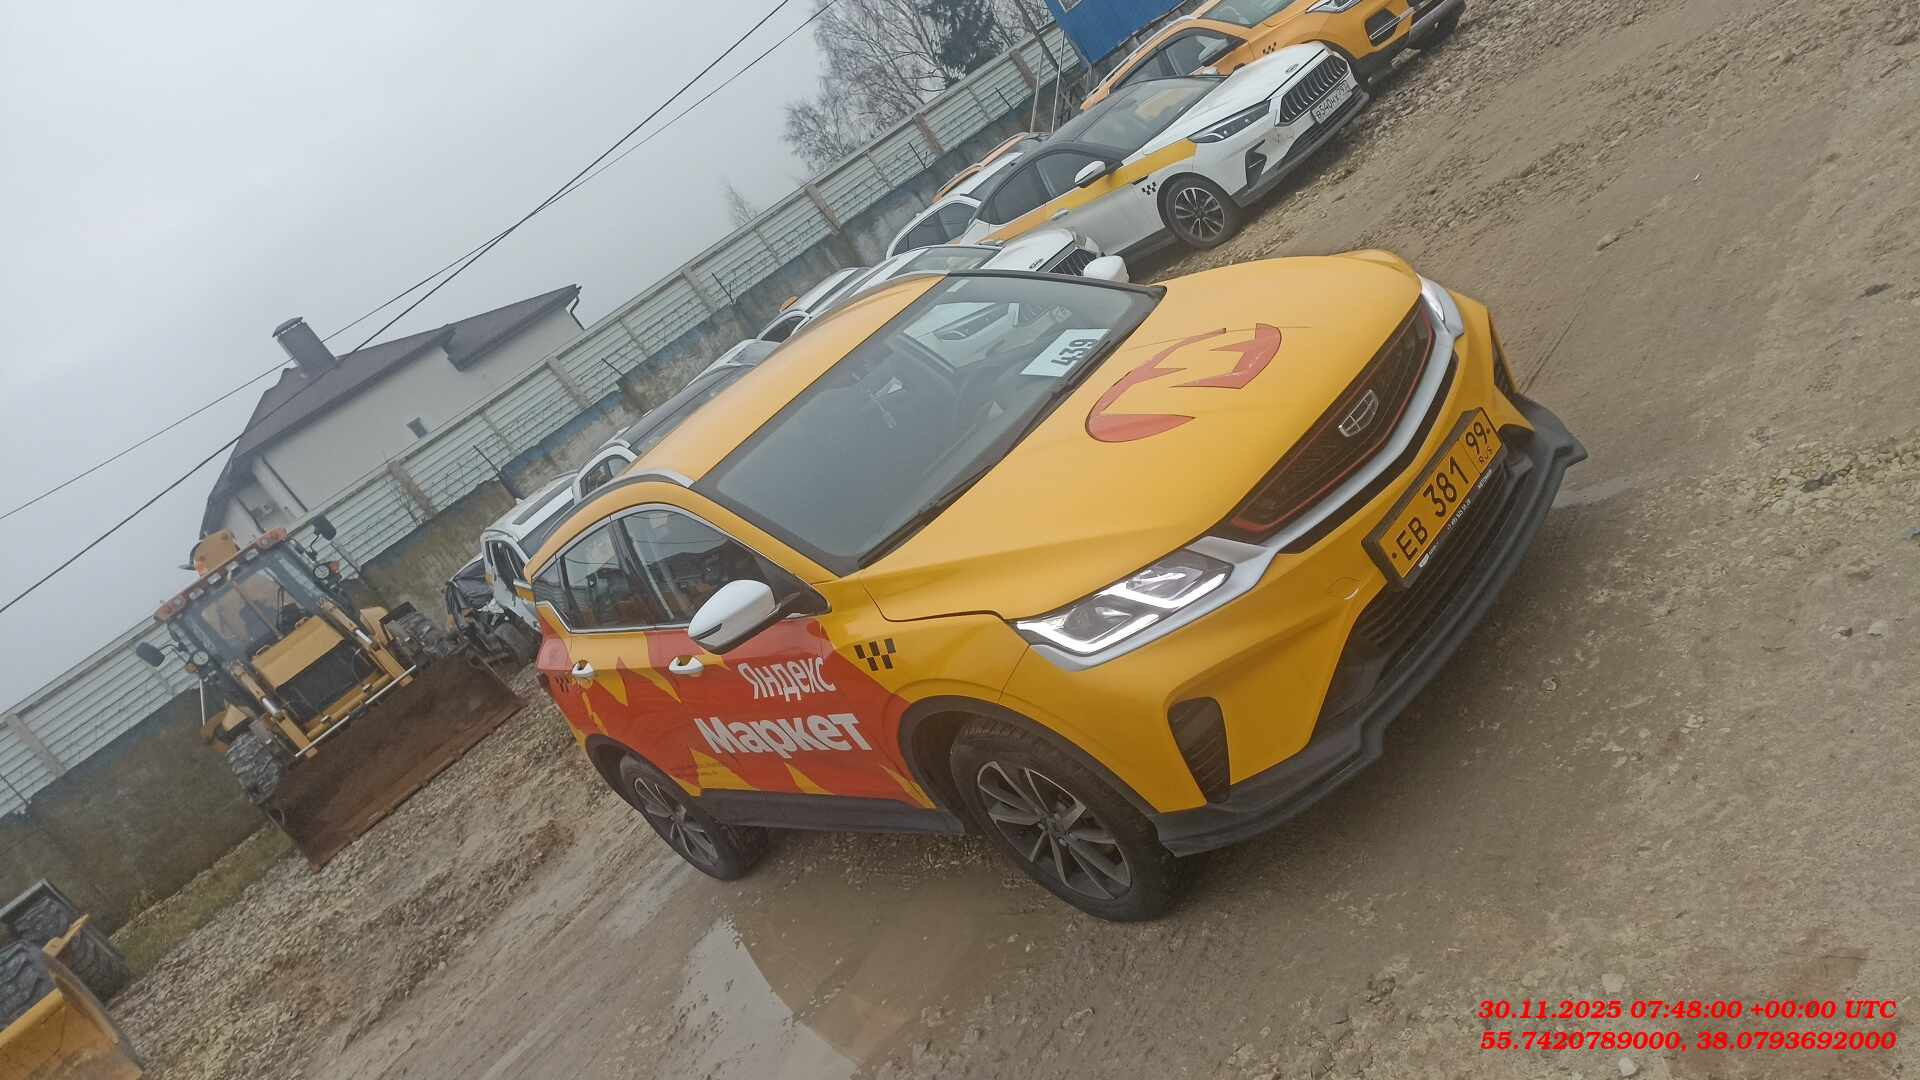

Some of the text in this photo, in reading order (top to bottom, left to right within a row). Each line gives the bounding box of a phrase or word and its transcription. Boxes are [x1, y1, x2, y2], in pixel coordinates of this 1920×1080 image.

[1050, 338, 1098, 367] 439
[1396, 516, 1428, 561] ЕВ
[1422, 455, 1469, 518] 381
[1465, 421, 1488, 456] 99
[737, 656, 837, 703] Яндекс
[693, 712, 873, 759] Маркет
